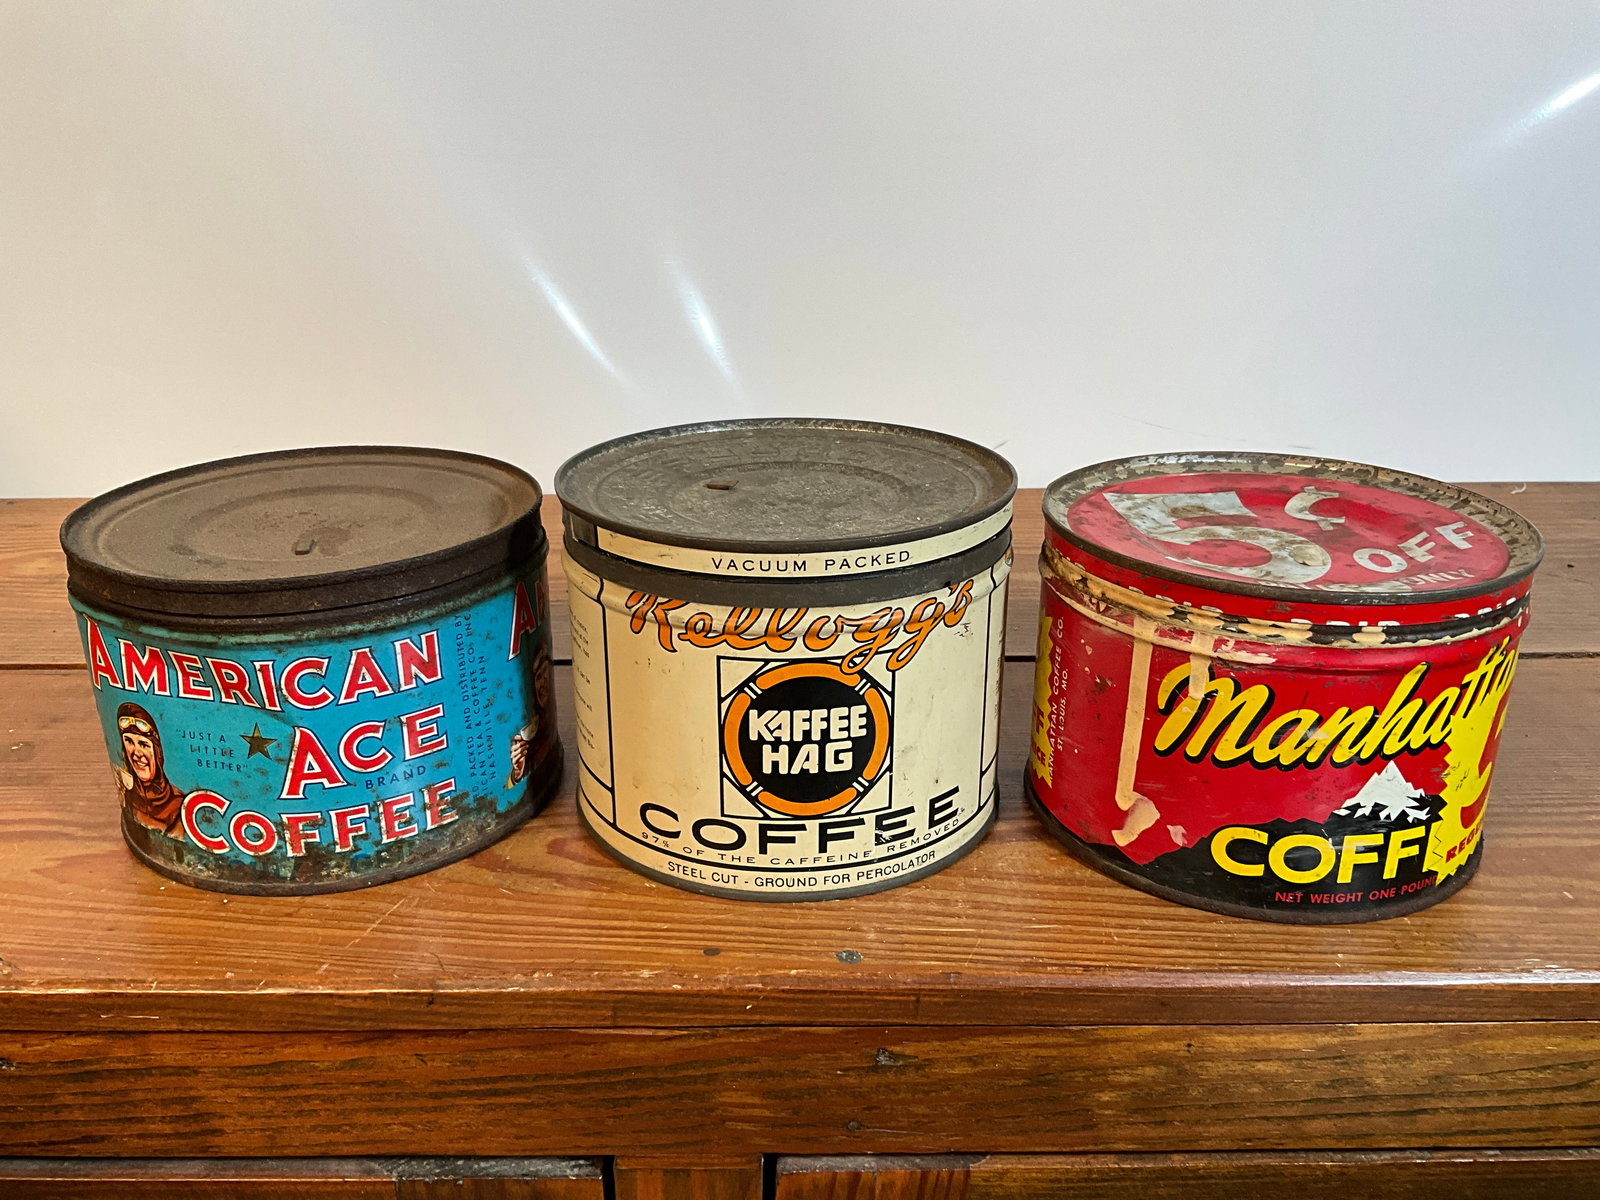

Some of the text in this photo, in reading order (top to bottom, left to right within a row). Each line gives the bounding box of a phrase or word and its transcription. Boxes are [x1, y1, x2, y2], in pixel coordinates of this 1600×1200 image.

[711, 550, 911, 572] VACUUM PACKED
[1353, 521, 1475, 573] OFF
[1400, 569, 1475, 585] ONLY
[454, 615, 462, 628] BY
[625, 579, 974, 673] Kellogg's
[1056, 616, 1064, 639] CO.
[83, 613, 443, 712] AMERICAN
[455, 633, 471, 702] DISTRIBUTED
[1053, 645, 1062, 695] COFFEE
[1061, 668, 1069, 691] MO.
[469, 668, 482, 715] COFFEE
[463, 707, 473, 730] AND
[748, 705, 868, 742] KAFFEE
[189, 744, 235, 758] LITTLE
[218, 735, 226, 744] A
[278, 702, 449, 800] ACE
[466, 736, 477, 778] PACKED
[476, 733, 485, 756] TEA
[762, 740, 854, 774] HAG
[365, 765, 428, 790] BRAND
[181, 778, 460, 858] COFFEE
[640, 785, 960, 855] COFFEE
[641, 818, 959, 865] 97% OF THE CAFFEINE REMOVED
[1211, 821, 1442, 884] COFF
[668, 861, 707, 880] STEEL
[711, 872, 739, 885] CUT
[754, 876, 818, 888] GROUND
[823, 873, 851, 885] FOR
[856, 850, 936, 881] PERCOLATOR
[1275, 891, 1304, 904] NET
[1309, 892, 1364, 904] WEIGHT
[1368, 887, 1396, 901] ONE
